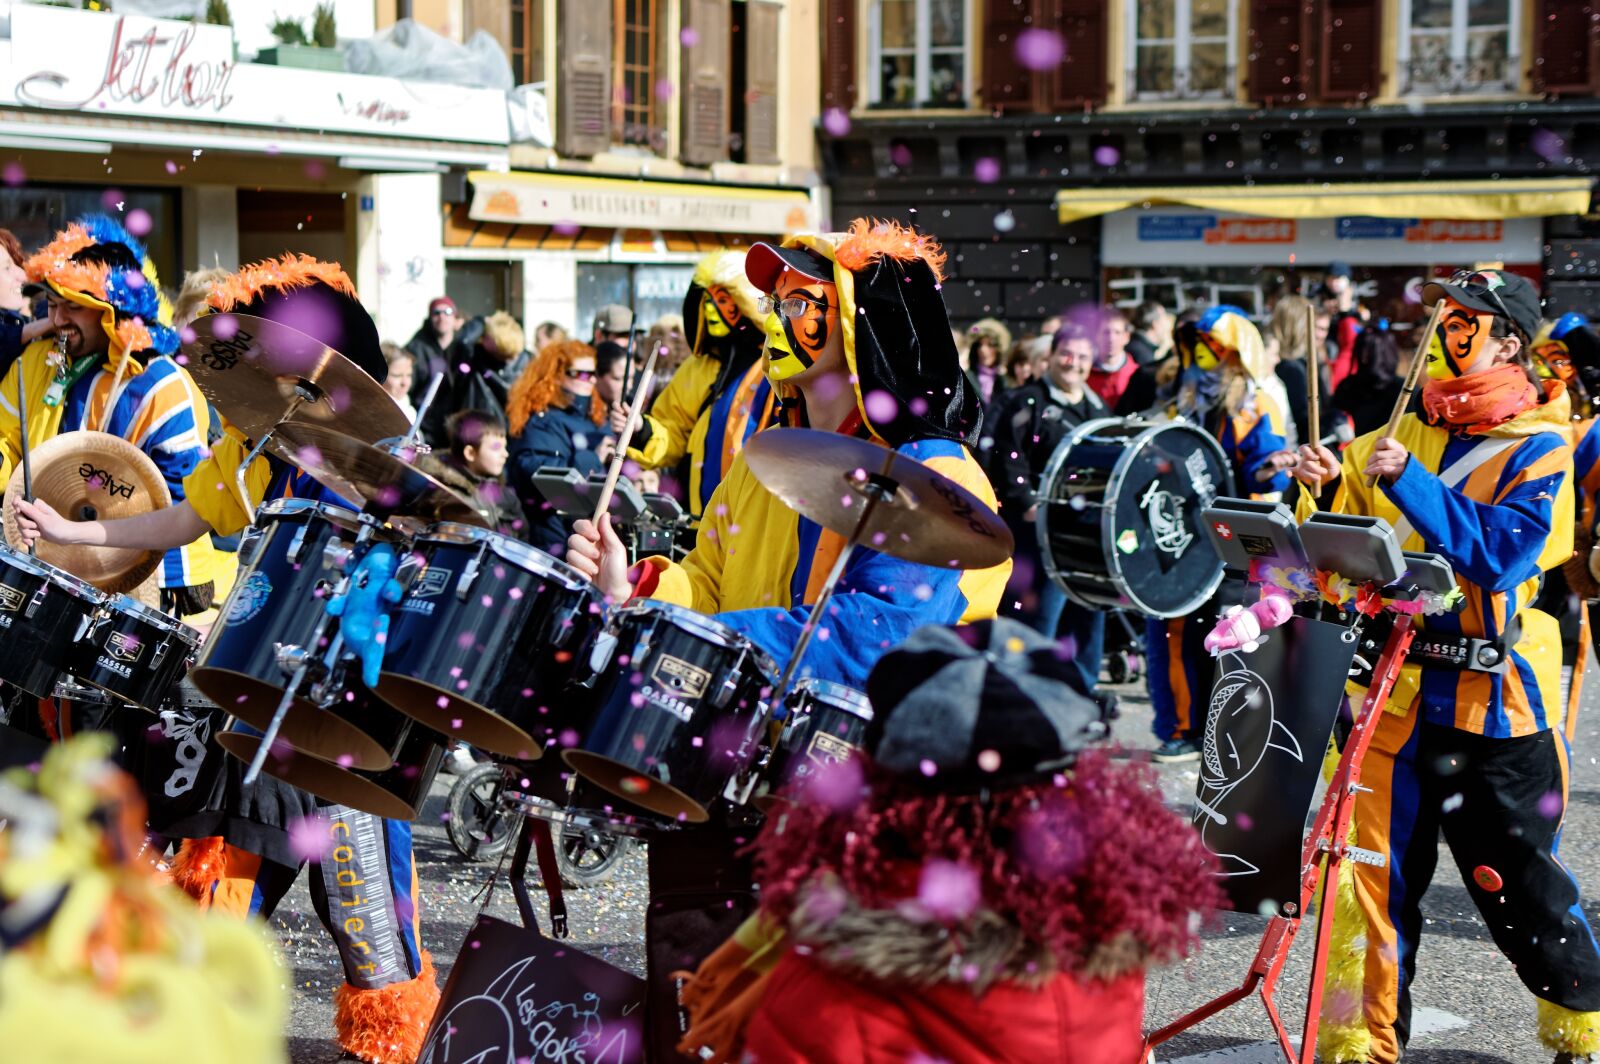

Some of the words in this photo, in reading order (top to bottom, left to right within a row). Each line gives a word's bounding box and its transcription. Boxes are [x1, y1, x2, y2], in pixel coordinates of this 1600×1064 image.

[404, 599, 435, 612] ASSER
[1413, 640, 1467, 657] GASSER
[97, 655, 133, 675] GASSER
[641, 685, 694, 715] GASSER
[329, 821, 377, 975] codiert
[516, 982, 537, 1026] Les
